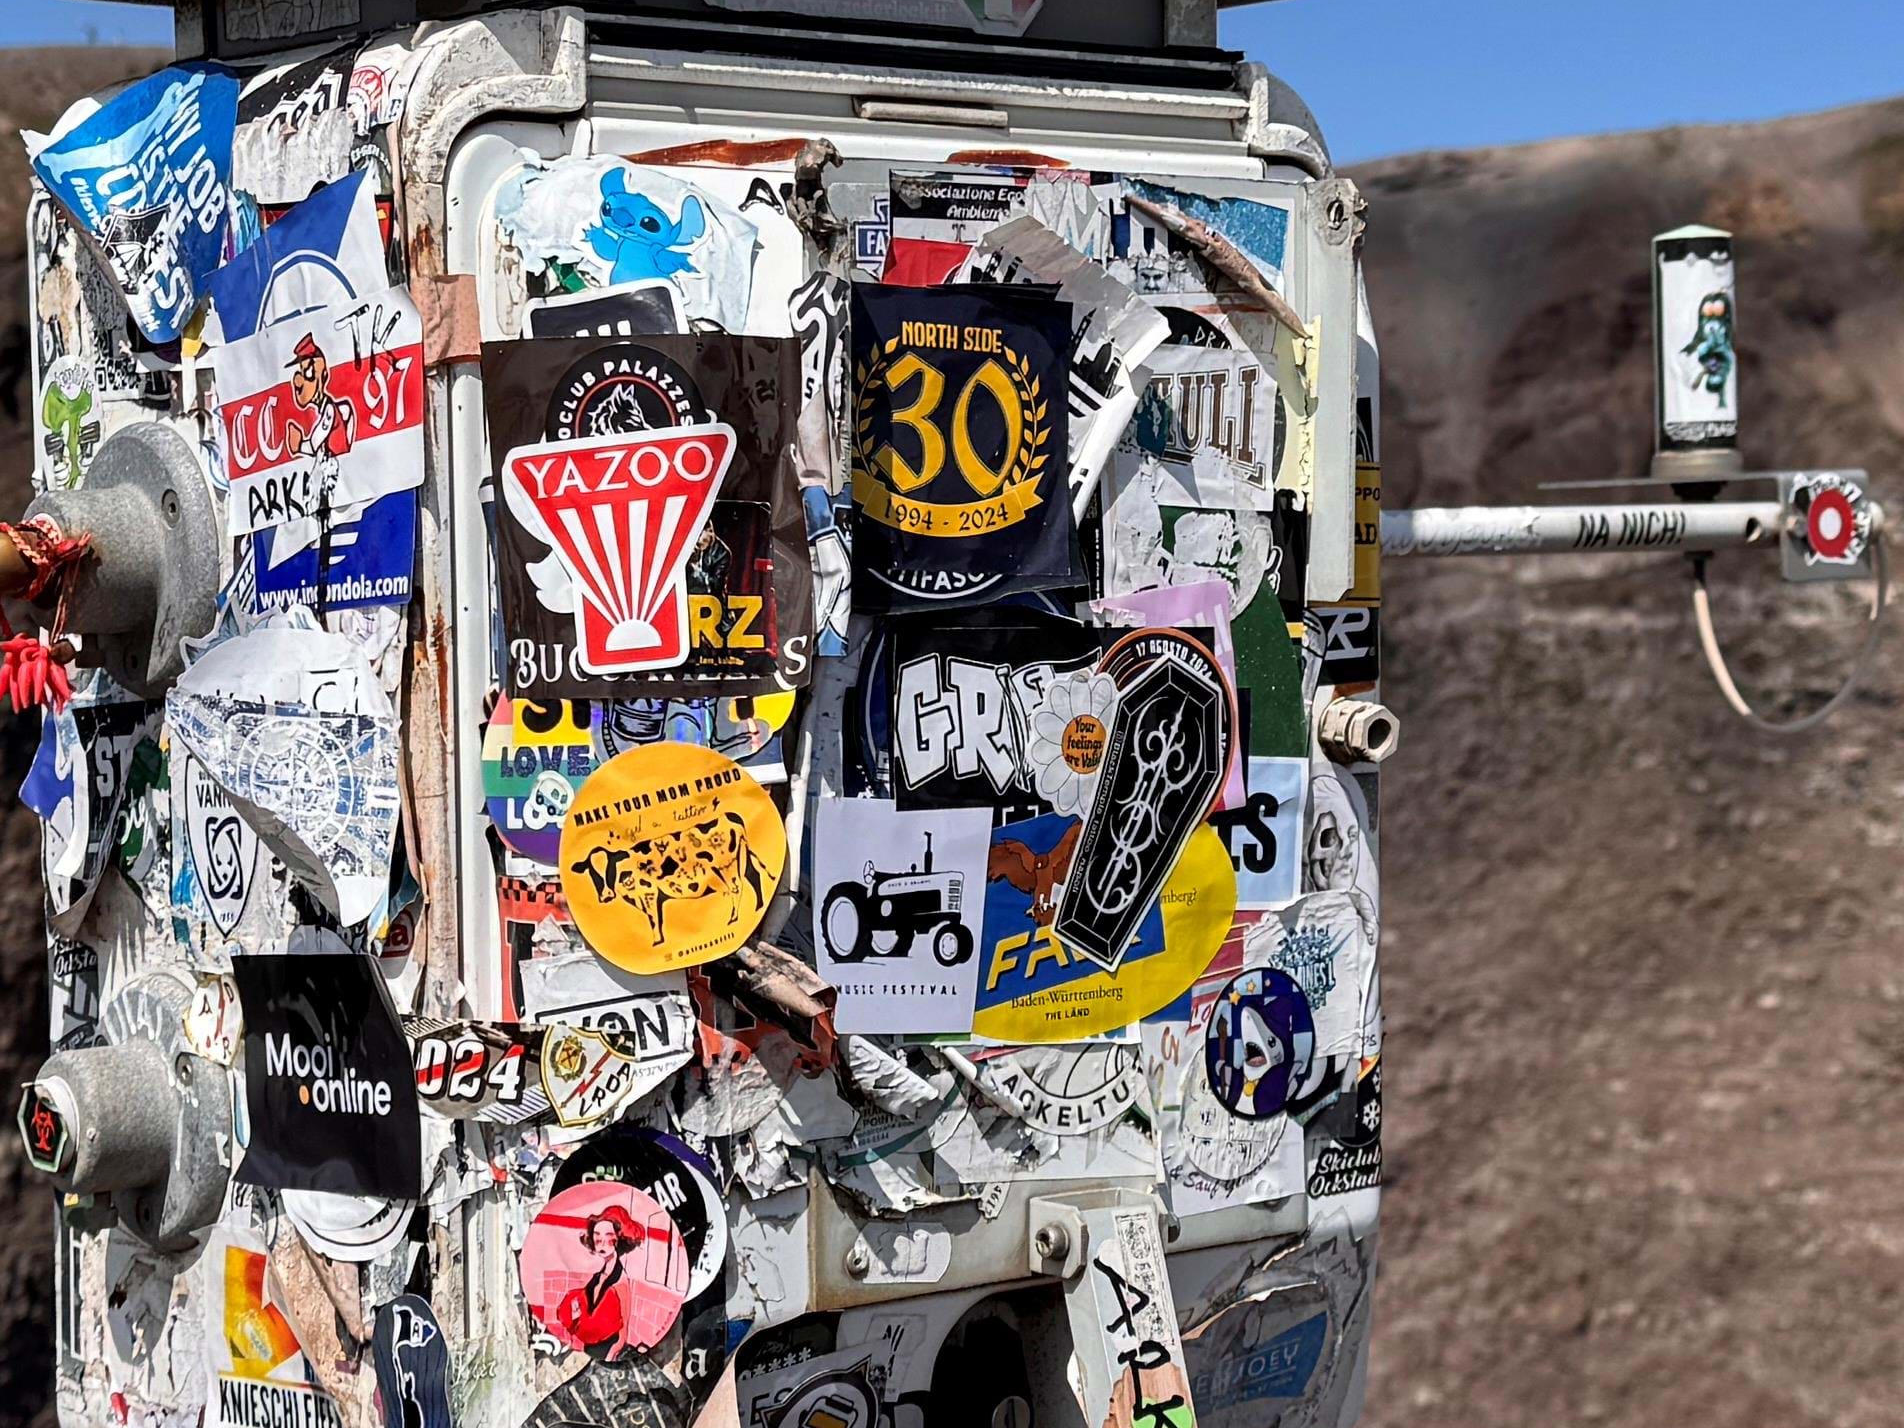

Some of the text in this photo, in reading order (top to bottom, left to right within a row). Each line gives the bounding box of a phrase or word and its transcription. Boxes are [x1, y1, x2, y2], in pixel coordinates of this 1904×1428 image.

[902, 321, 1003, 354] NORTH SIDE
[872, 351, 1023, 498] 30
[523, 440, 715, 500] YAZOO
[883, 504, 934, 531] 1994
[958, 504, 1010, 532] 2024
[1573, 515, 1610, 548] NA
[573, 767, 742, 827] MAKE YOUR MOM PROUD
[882, 984, 958, 996] FESTIVAL
[1045, 1010, 1062, 1022] THE
[264, 1031, 334, 1078] Mooi
[413, 1036, 526, 1104] 024
[312, 1067, 392, 1117] online
